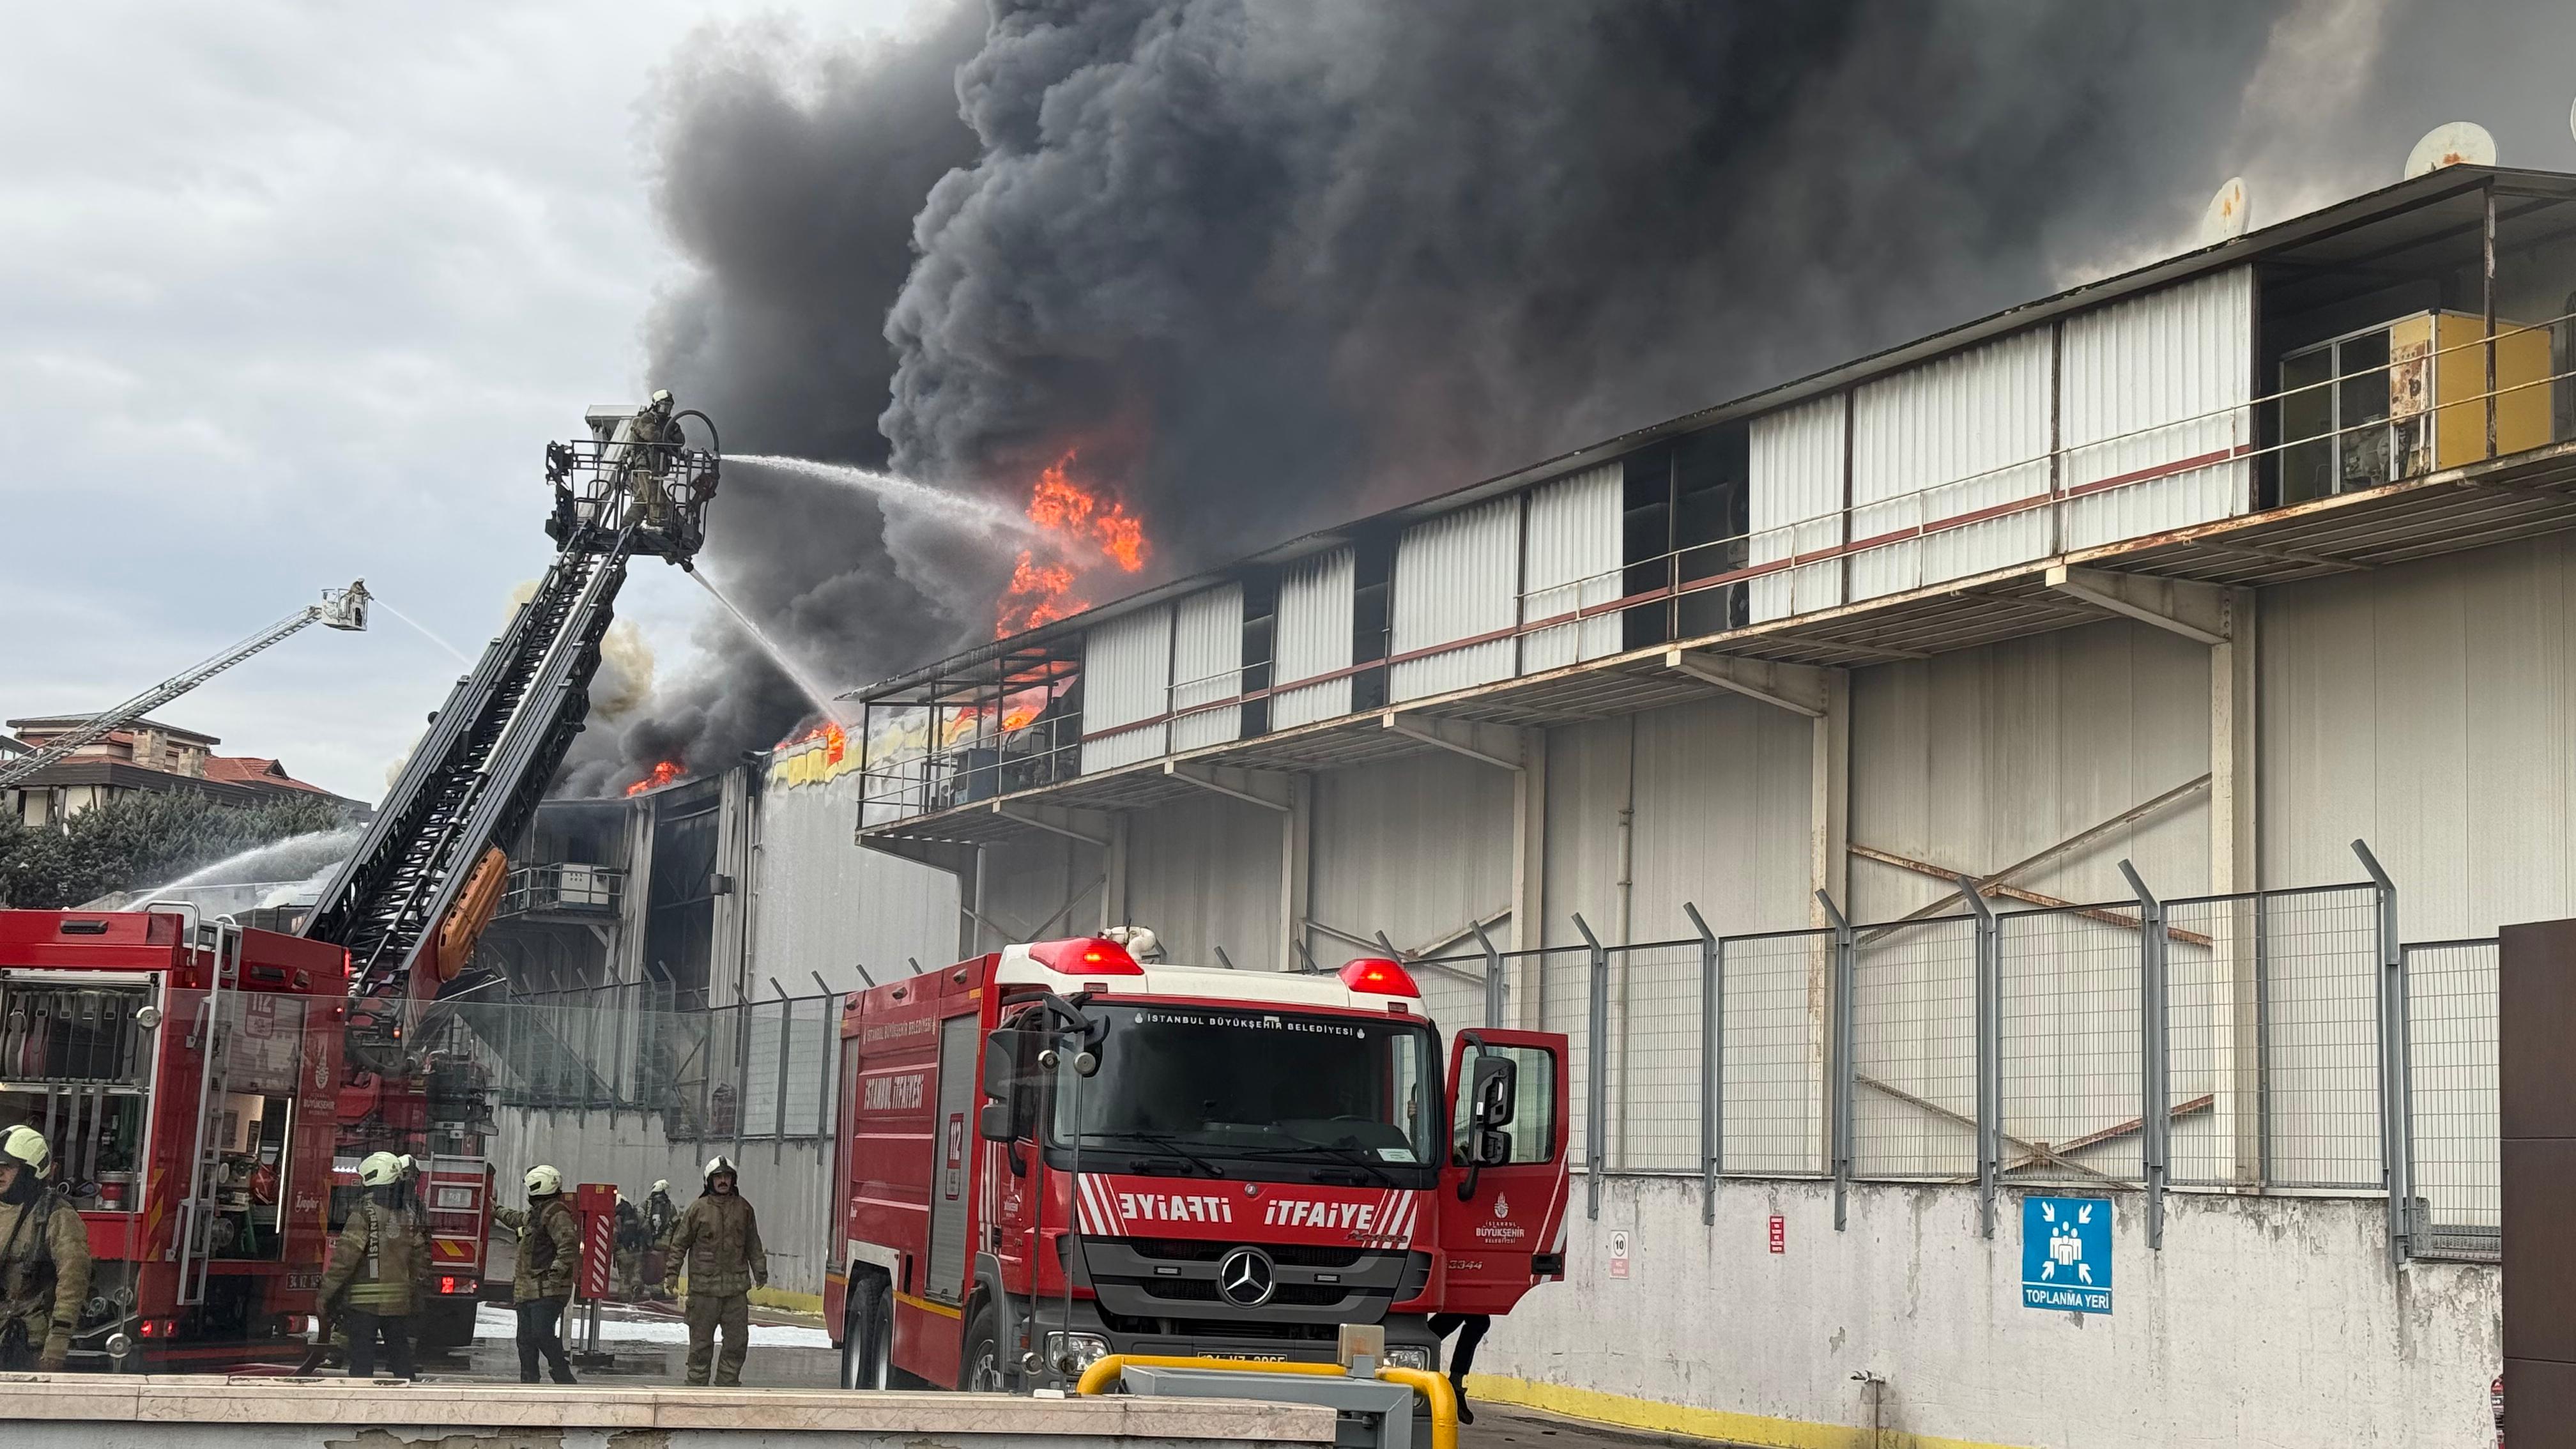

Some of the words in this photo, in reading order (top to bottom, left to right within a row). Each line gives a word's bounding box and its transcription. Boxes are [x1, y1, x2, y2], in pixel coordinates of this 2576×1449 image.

[1147, 1013, 1204, 1025] İSTANBUL
[1209, 1017, 1282, 1030] BÜYÜKŞEHİR
[1287, 1023, 1353, 1036] BELEDİYESİ
[949, 1121, 962, 1160] 112
[1475, 1225, 1525, 1239] BÜYÜKŞEHİR
[1615, 1239, 1624, 1250] 10
[2026, 1289, 2083, 1307] TOPLANMA
[2085, 1292, 2109, 1309] YERİ
